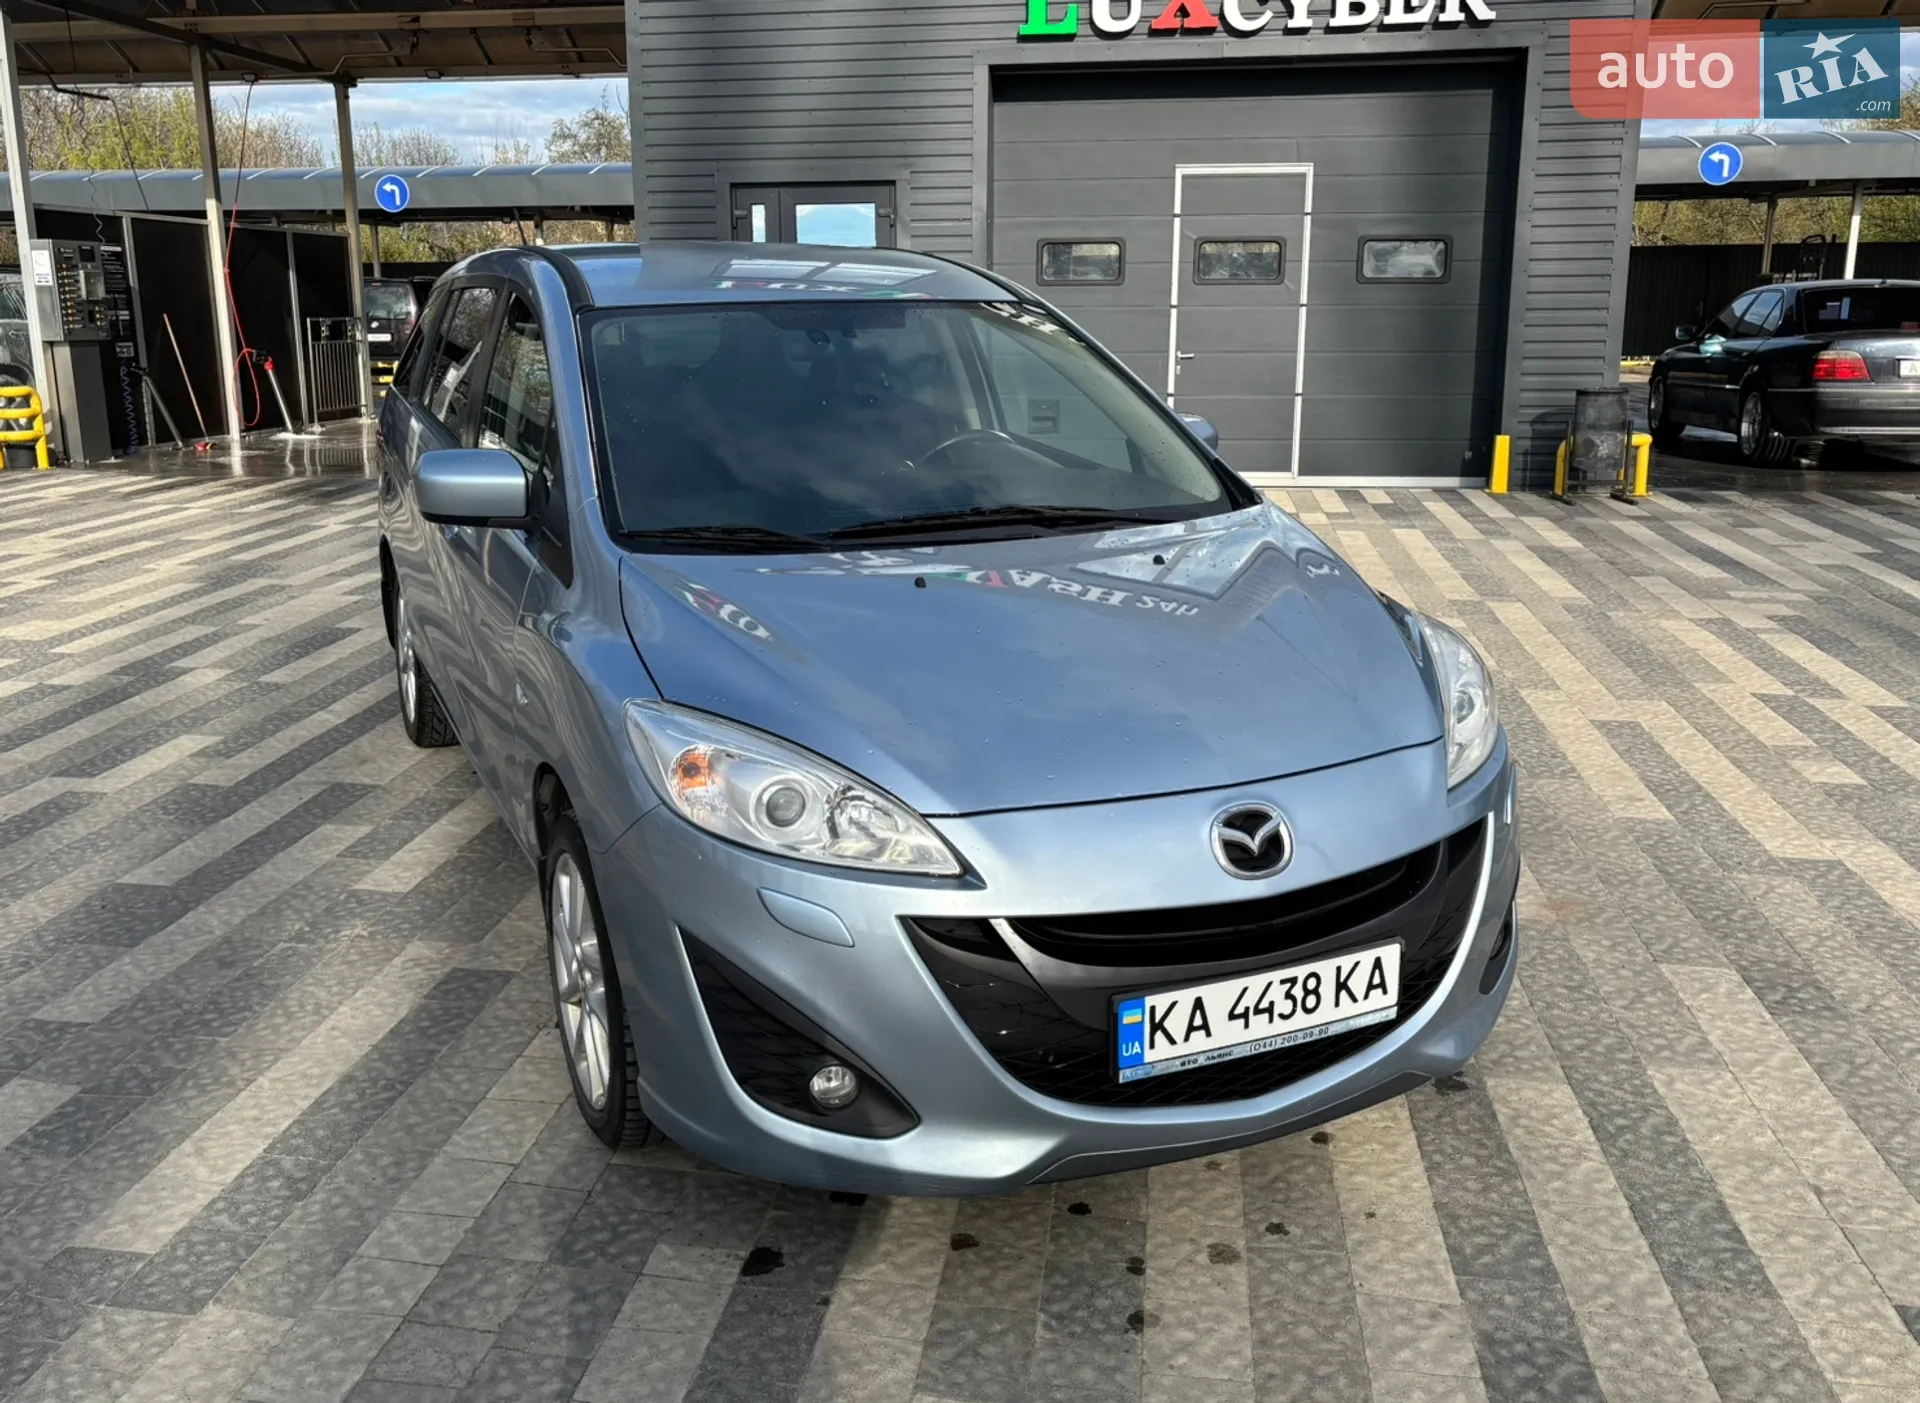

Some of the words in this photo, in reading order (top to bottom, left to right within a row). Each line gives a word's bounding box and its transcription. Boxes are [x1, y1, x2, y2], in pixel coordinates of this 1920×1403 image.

[1149, 996, 1212, 1050] KA
[1227, 971, 1322, 1029] 4438
[1334, 956, 1389, 1008] KA
[1122, 1040, 1142, 1057] UA
[1201, 1050, 1235, 1062] льянс
